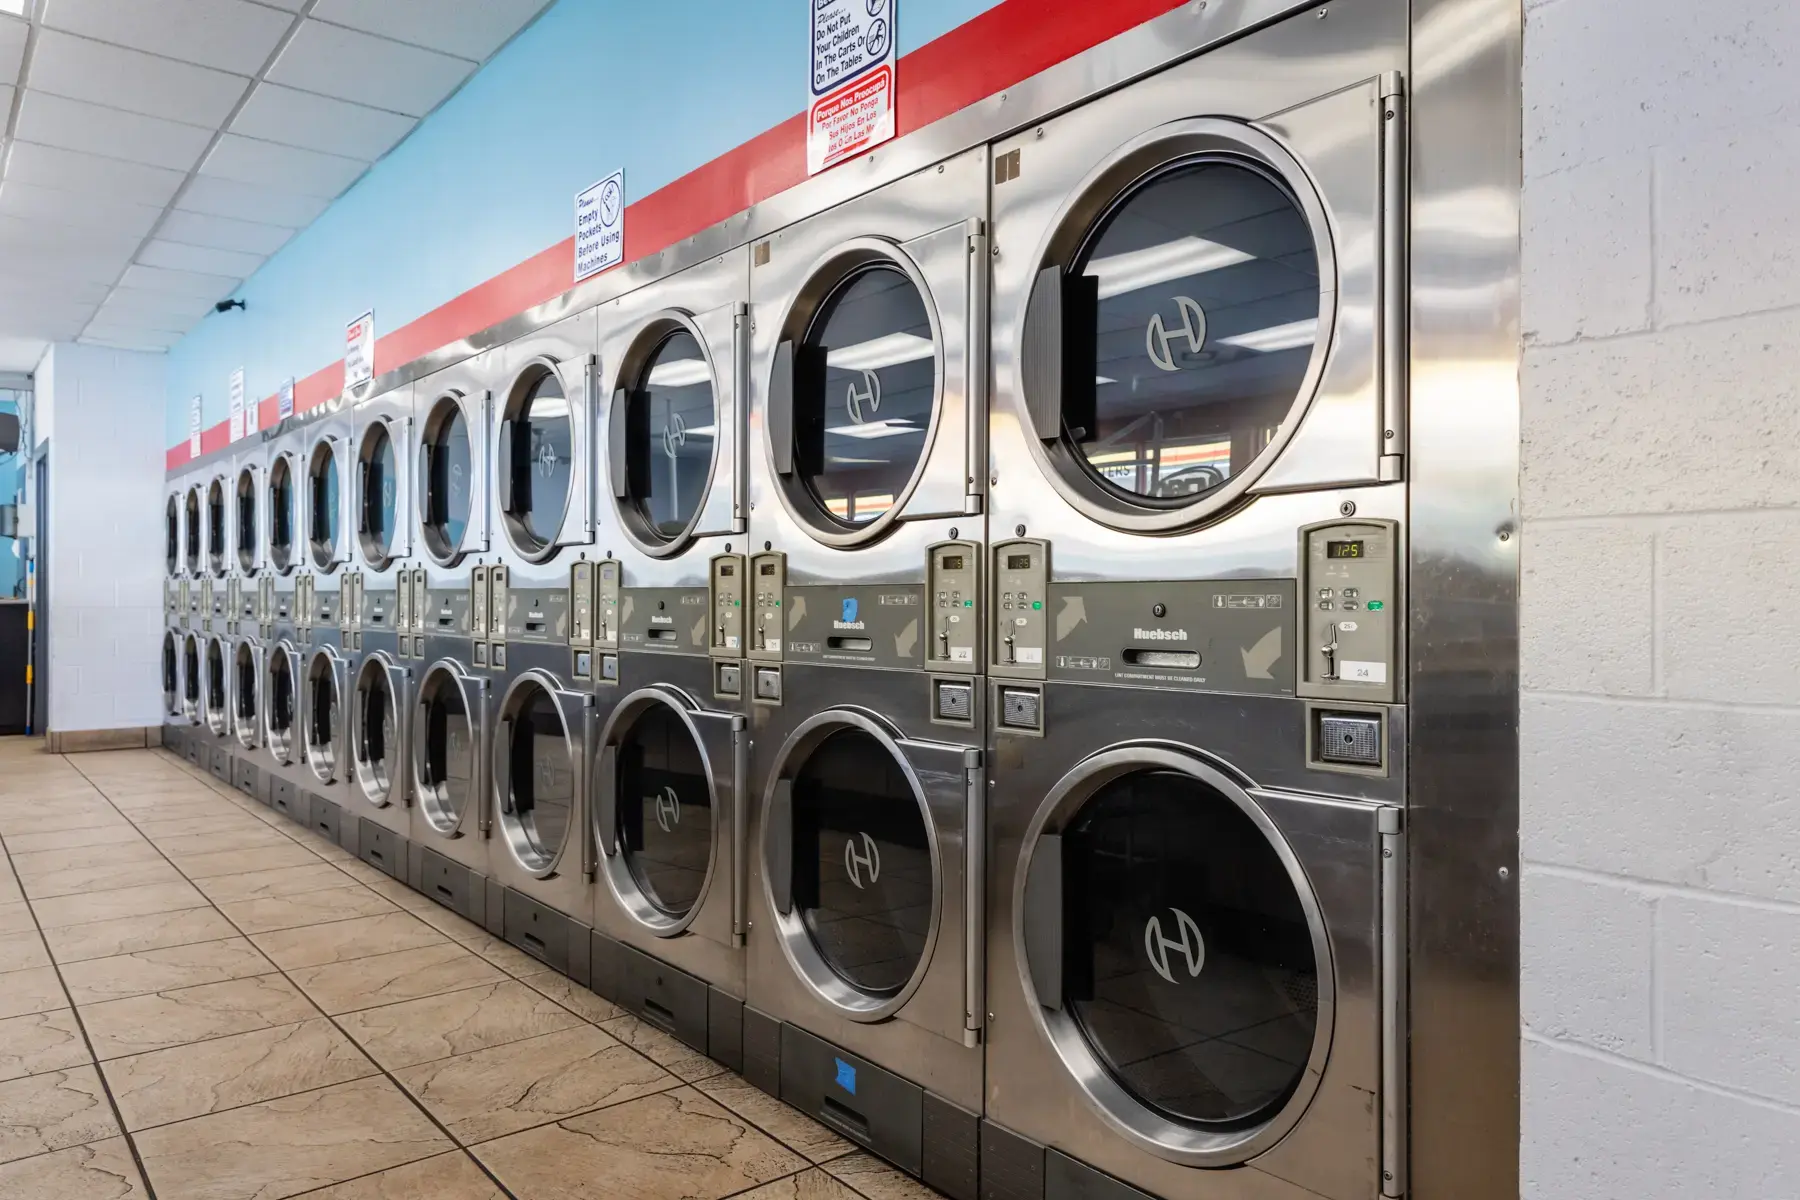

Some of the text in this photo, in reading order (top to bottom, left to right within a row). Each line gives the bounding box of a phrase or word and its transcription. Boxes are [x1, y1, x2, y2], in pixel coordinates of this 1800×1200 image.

[816, 12, 851, 41] Do Not Put
[816, 24, 860, 55] Your Children
[816, 35, 866, 71] In The Carts Or
[816, 53, 863, 85] On The Tables
[821, 97, 879, 130] Por Favor No Ponga
[840, 97, 853, 109] Nos
[829, 130, 839, 140] Sus
[840, 121, 856, 134] Hijos
[856, 117, 865, 126] En
[866, 111, 877, 122] Los
[853, 130, 865, 141] Las
[578, 209, 599, 226] Empty
[578, 224, 602, 242] Pockets
[578, 230, 620, 258] Before Using
[578, 253, 608, 274] Machines
[1337, 544, 1358, 557] 125
[1133, 628, 1188, 641] Huebsch
[1356, 668, 1369, 677] 24
